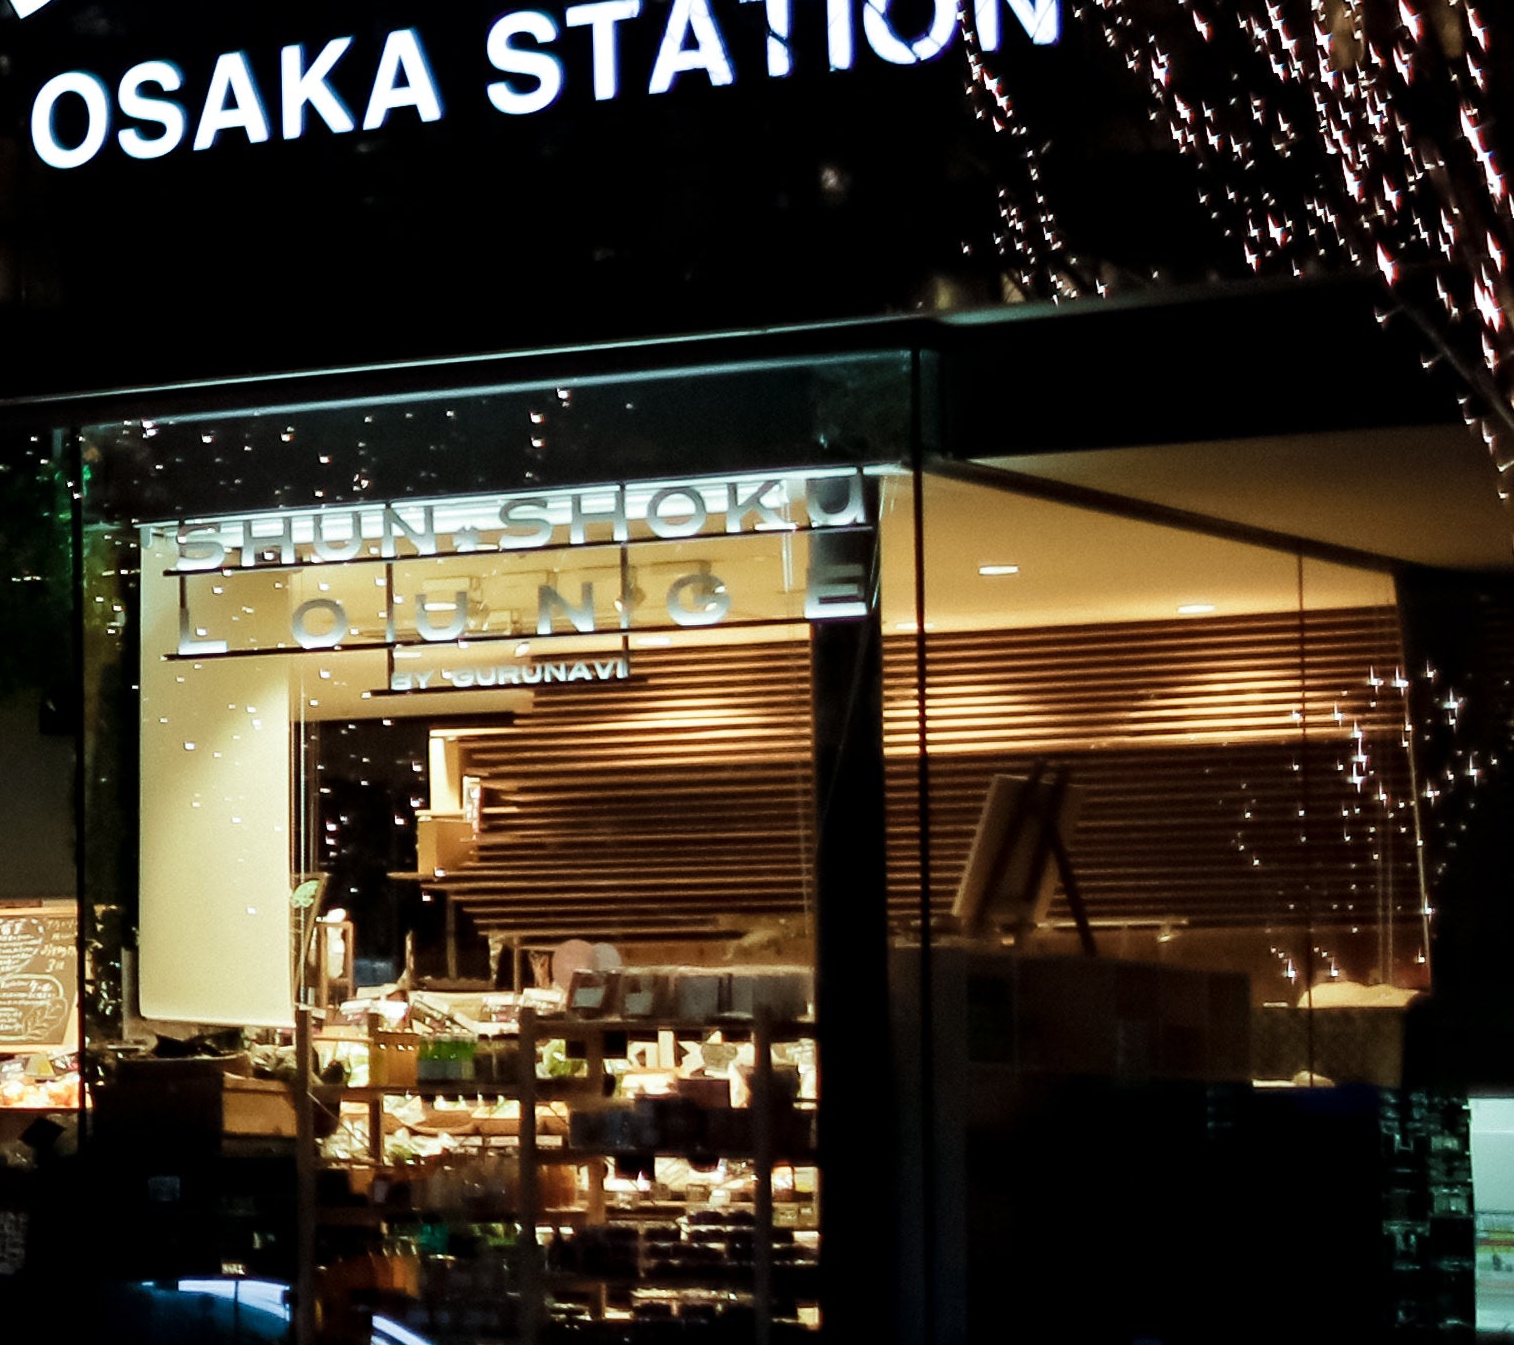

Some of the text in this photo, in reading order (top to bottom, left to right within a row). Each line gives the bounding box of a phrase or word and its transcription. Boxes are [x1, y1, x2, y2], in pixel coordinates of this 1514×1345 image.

[29, 27, 443, 171] OSAKA
[175, 475, 867, 572] SHUN SHOKU
[177, 562, 869, 656] LOUNGE
[449, 659, 629, 688] GURUNAVI
